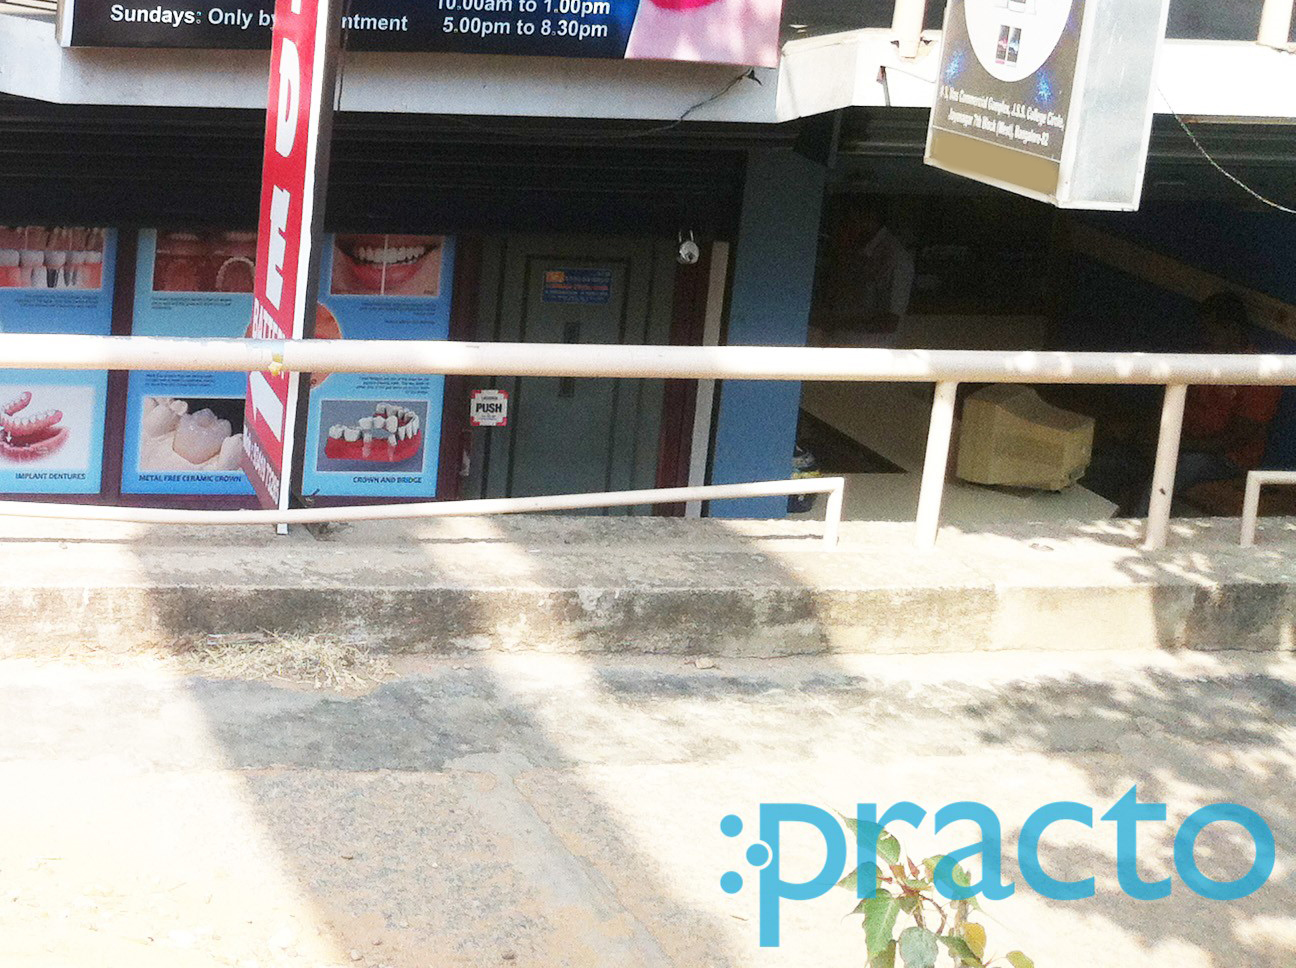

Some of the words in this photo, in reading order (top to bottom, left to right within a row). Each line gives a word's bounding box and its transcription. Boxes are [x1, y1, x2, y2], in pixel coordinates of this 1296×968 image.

[110, 4, 201, 28] Sundays:
[208, 8, 253, 30] Only
[341, 14, 408, 32] ntment
[442, 17, 511, 38] 5.00pm
[516, 19, 535, 35] to
[540, 19, 608, 40] 8.30pm
[476, 403, 502, 413] PUSH
[15, 472, 48, 480] IMPLANT
[49, 472, 86, 481] DENTURES
[139, 474, 162, 482] METAL
[164, 474, 180, 482] FREE
[353, 476, 382, 484] CROWN
[383, 476, 397, 484] AND
[398, 476, 422, 484] BRIDGE
